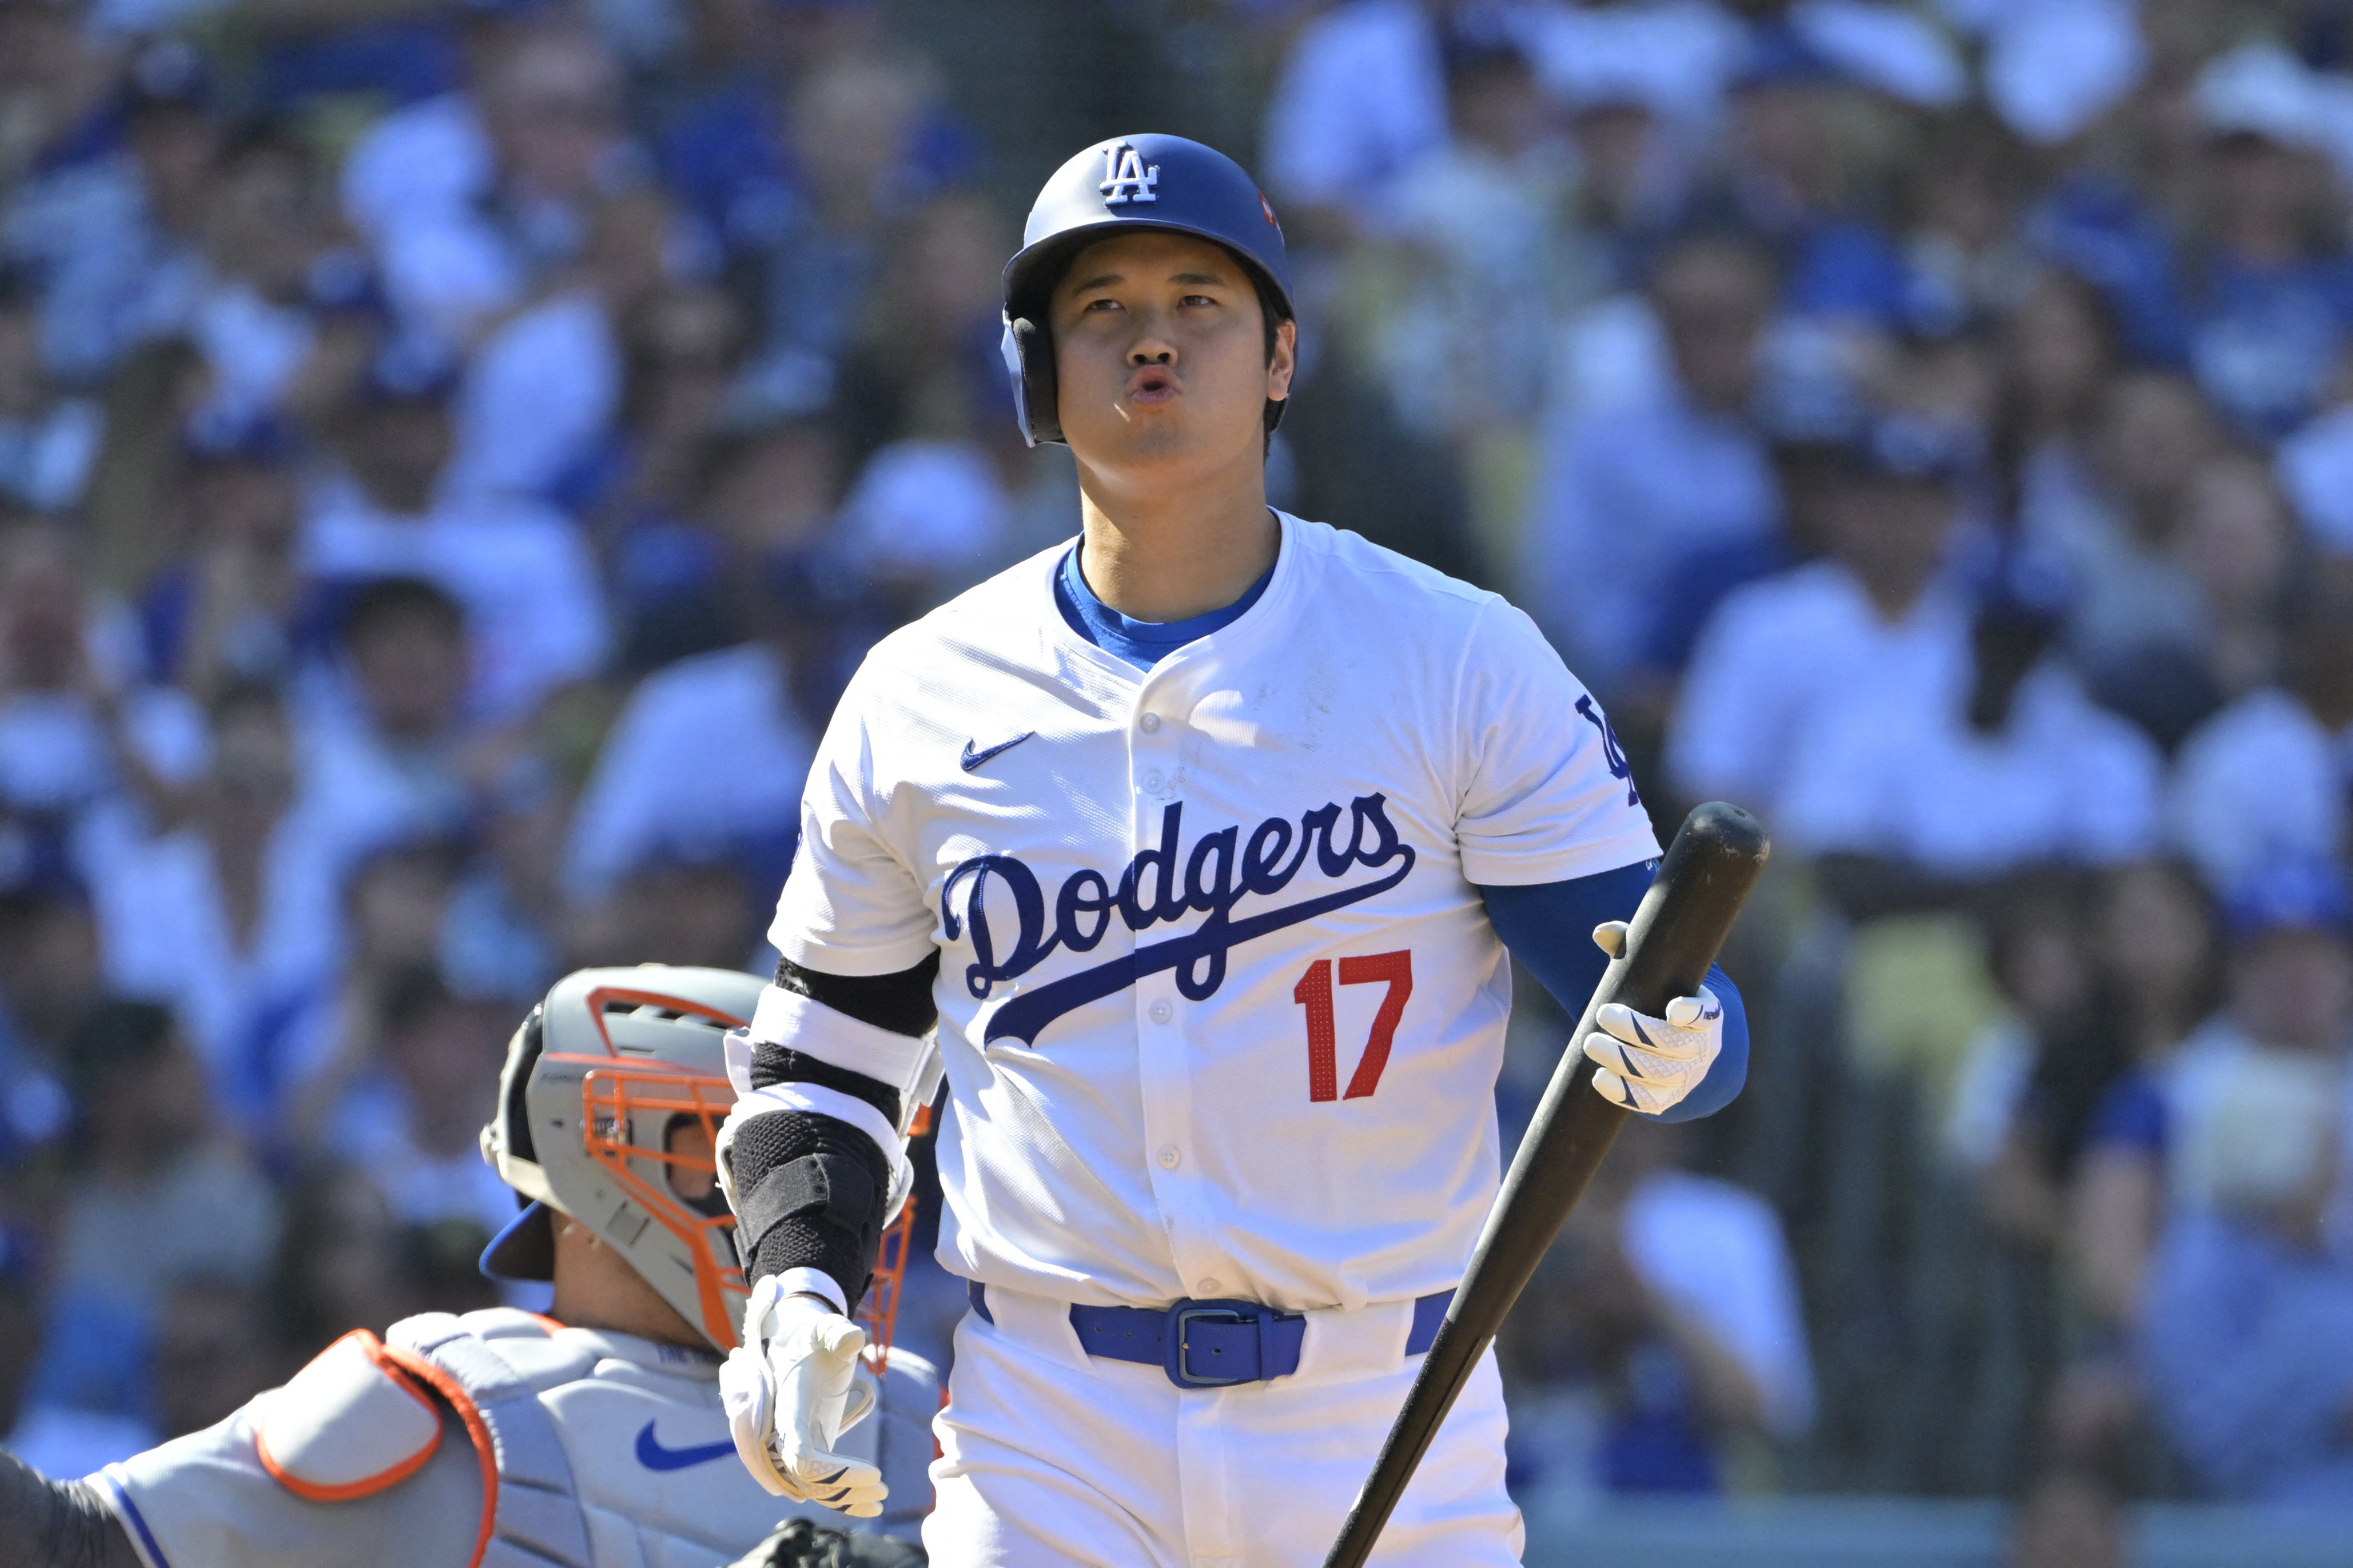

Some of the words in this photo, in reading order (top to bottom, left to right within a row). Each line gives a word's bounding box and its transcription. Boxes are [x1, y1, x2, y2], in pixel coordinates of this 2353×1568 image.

[1100, 140, 1158, 204] LA
[941, 792, 1416, 1003] Dodgers
[1293, 949, 1413, 1103] 17
